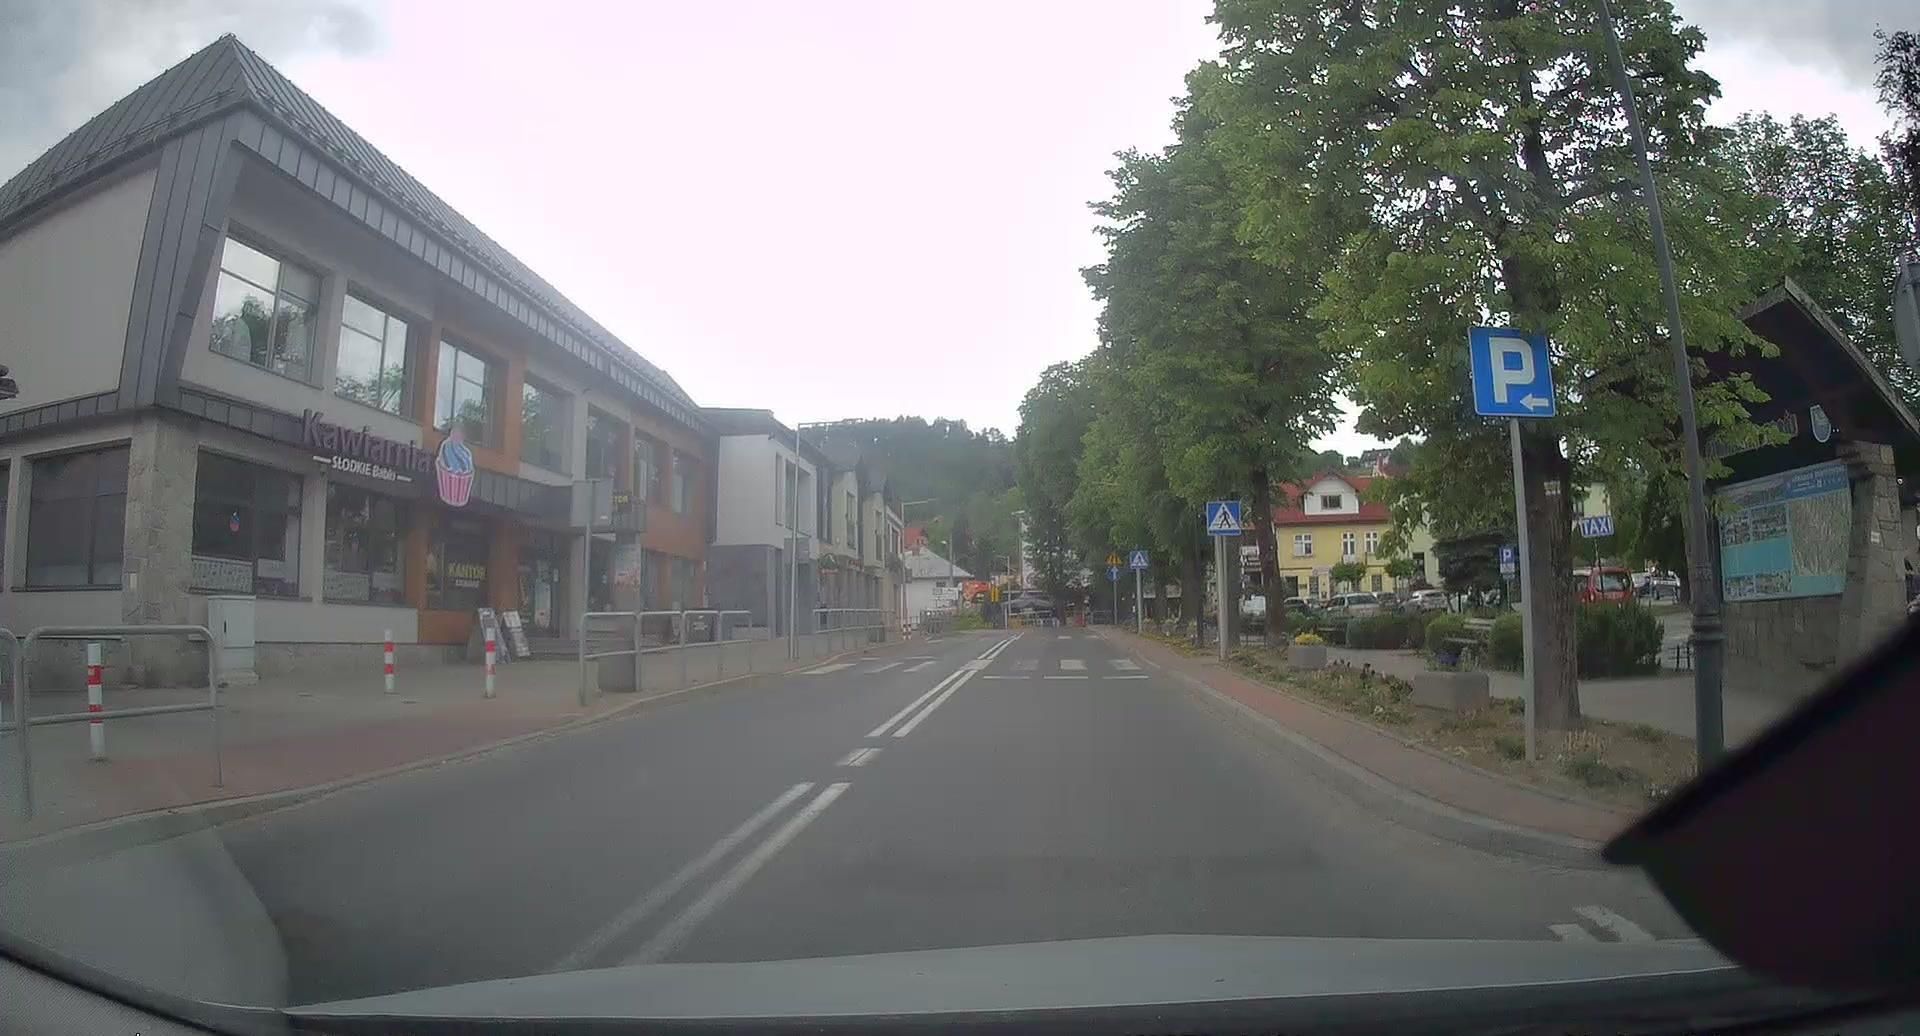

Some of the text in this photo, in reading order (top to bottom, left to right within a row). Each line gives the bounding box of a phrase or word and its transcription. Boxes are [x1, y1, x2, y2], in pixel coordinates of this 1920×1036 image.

[1489, 337, 1535, 404] P
[303, 408, 433, 474] Kawiarnia
[1583, 517, 1612, 536] TAXI
[1503, 548, 1512, 562] P
[448, 562, 486, 579] KANTOR
